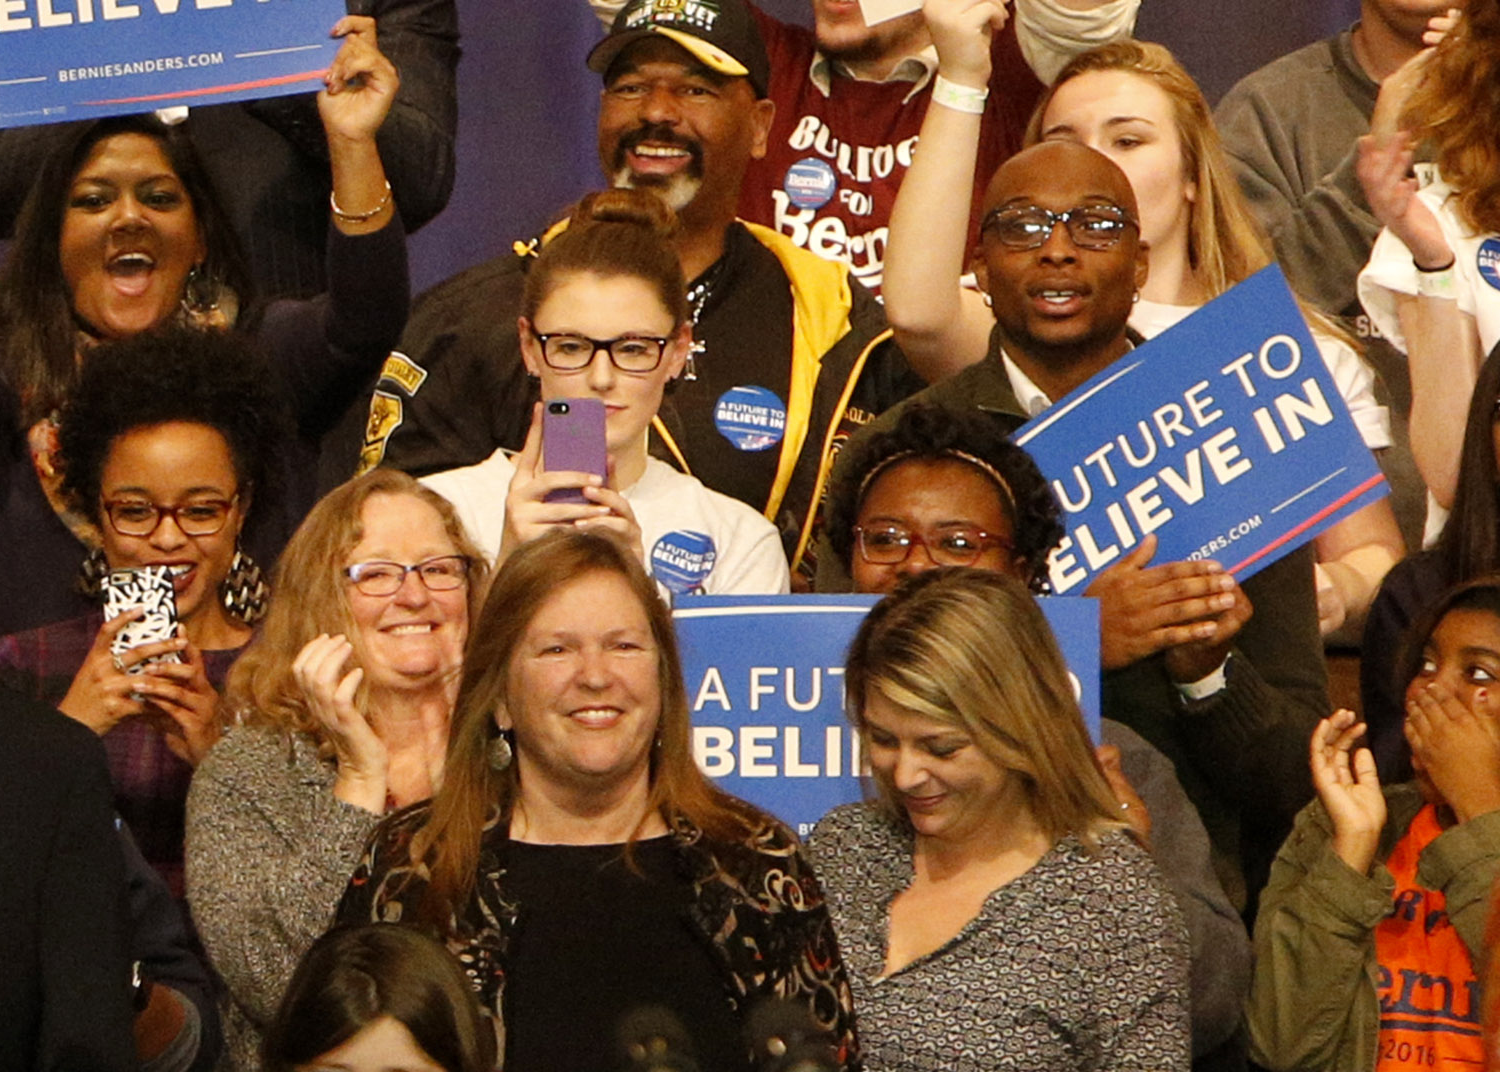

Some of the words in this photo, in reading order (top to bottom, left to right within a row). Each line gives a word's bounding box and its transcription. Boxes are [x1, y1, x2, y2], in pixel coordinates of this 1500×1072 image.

[684, 1, 717, 25] VET
[58, 51, 225, 83] BERNIESANDERS.COM
[839, 188, 874, 216] FO
[1220, 334, 1302, 398] TO
[716, 409, 768, 427] BELIEVE
[769, 418, 785, 430] IN
[728, 402, 768, 416] FUTURE
[771, 408, 786, 419] TO
[1252, 377, 1335, 455] IN
[693, 666, 733, 711] A
[1384, 1038, 1437, 1067] 2016
